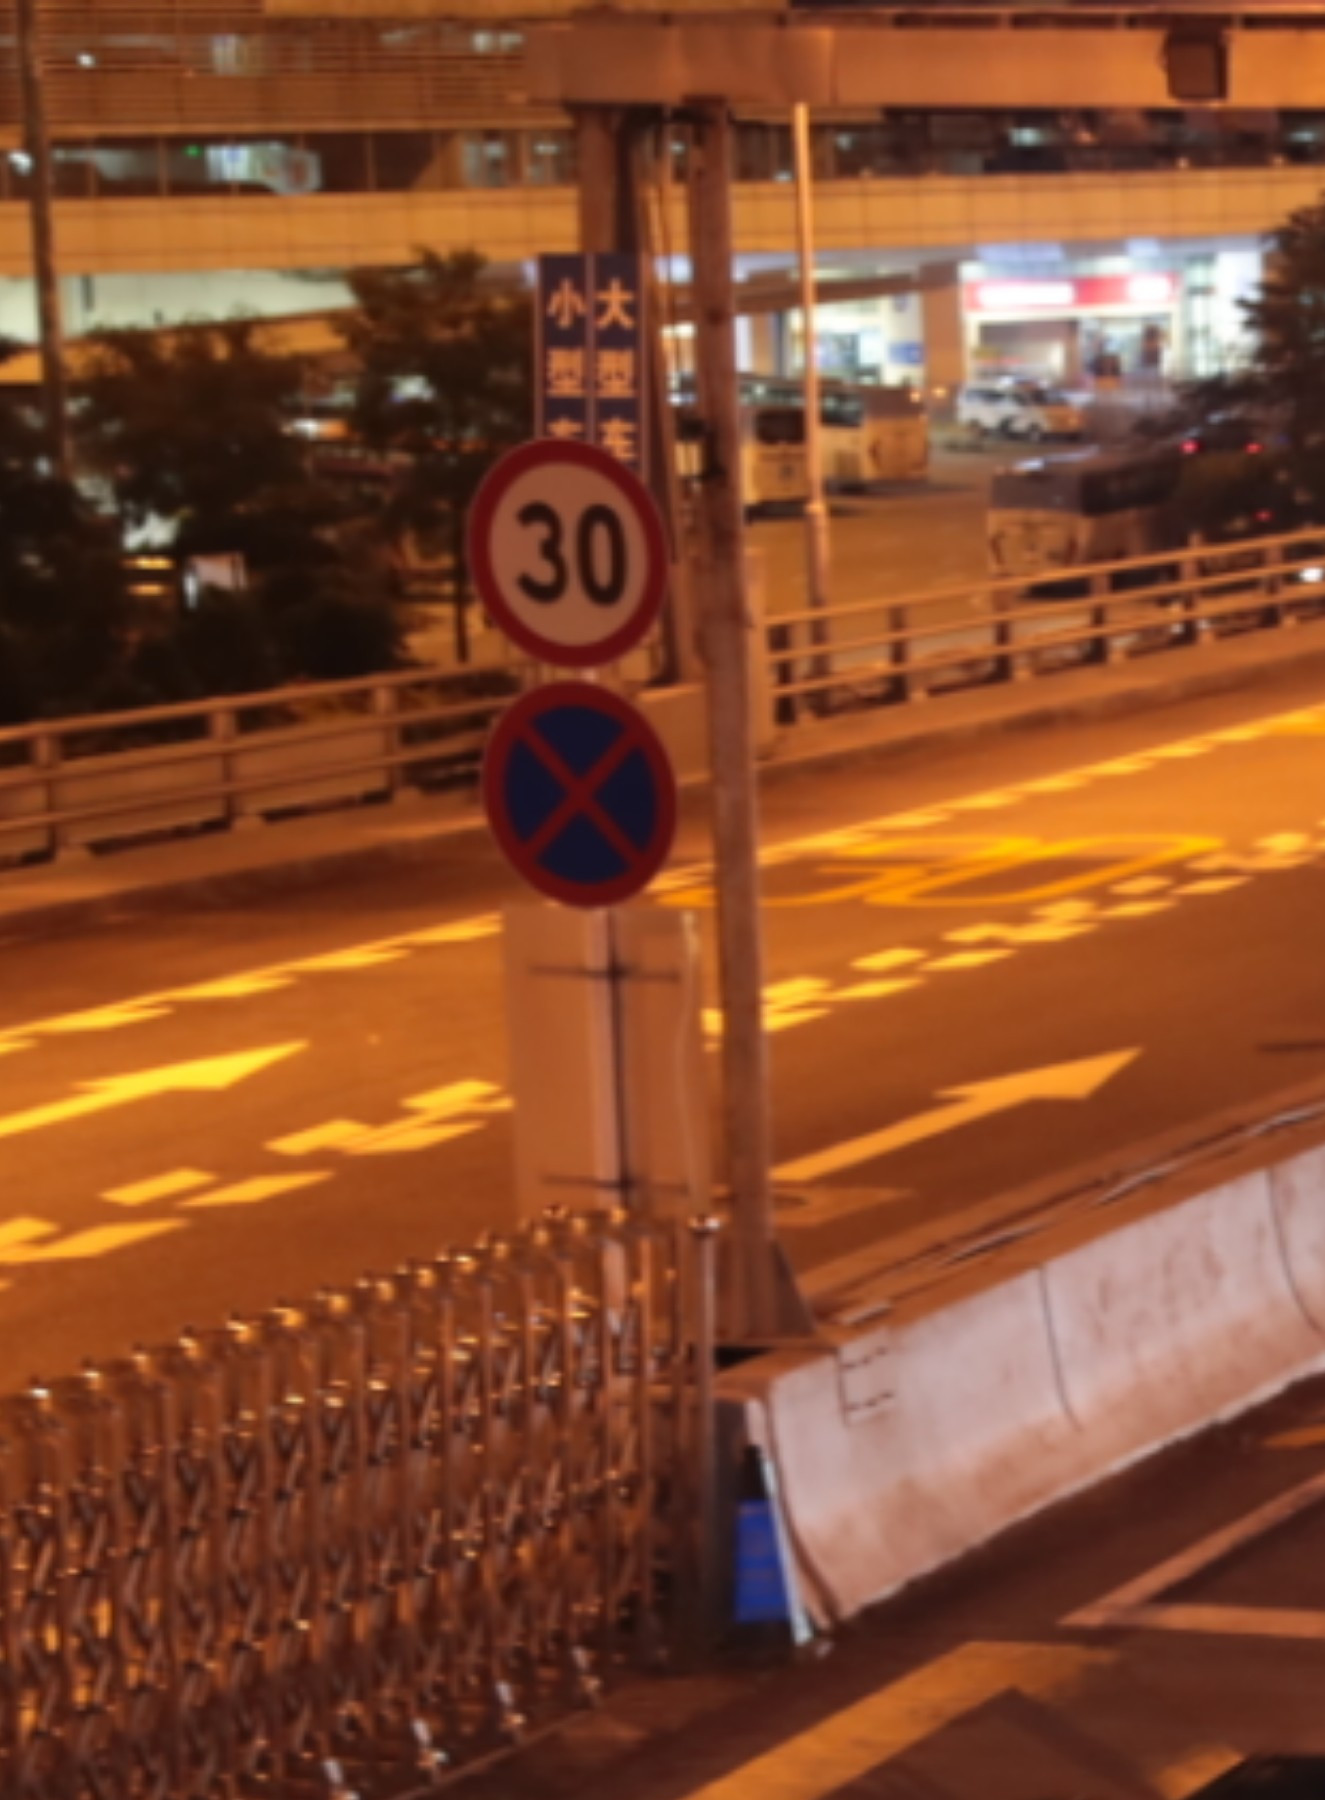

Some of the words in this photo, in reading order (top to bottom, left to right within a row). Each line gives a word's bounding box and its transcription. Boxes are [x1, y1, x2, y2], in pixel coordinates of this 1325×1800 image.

[595, 278, 636, 462] 大型车
[517, 501, 628, 606] 30
